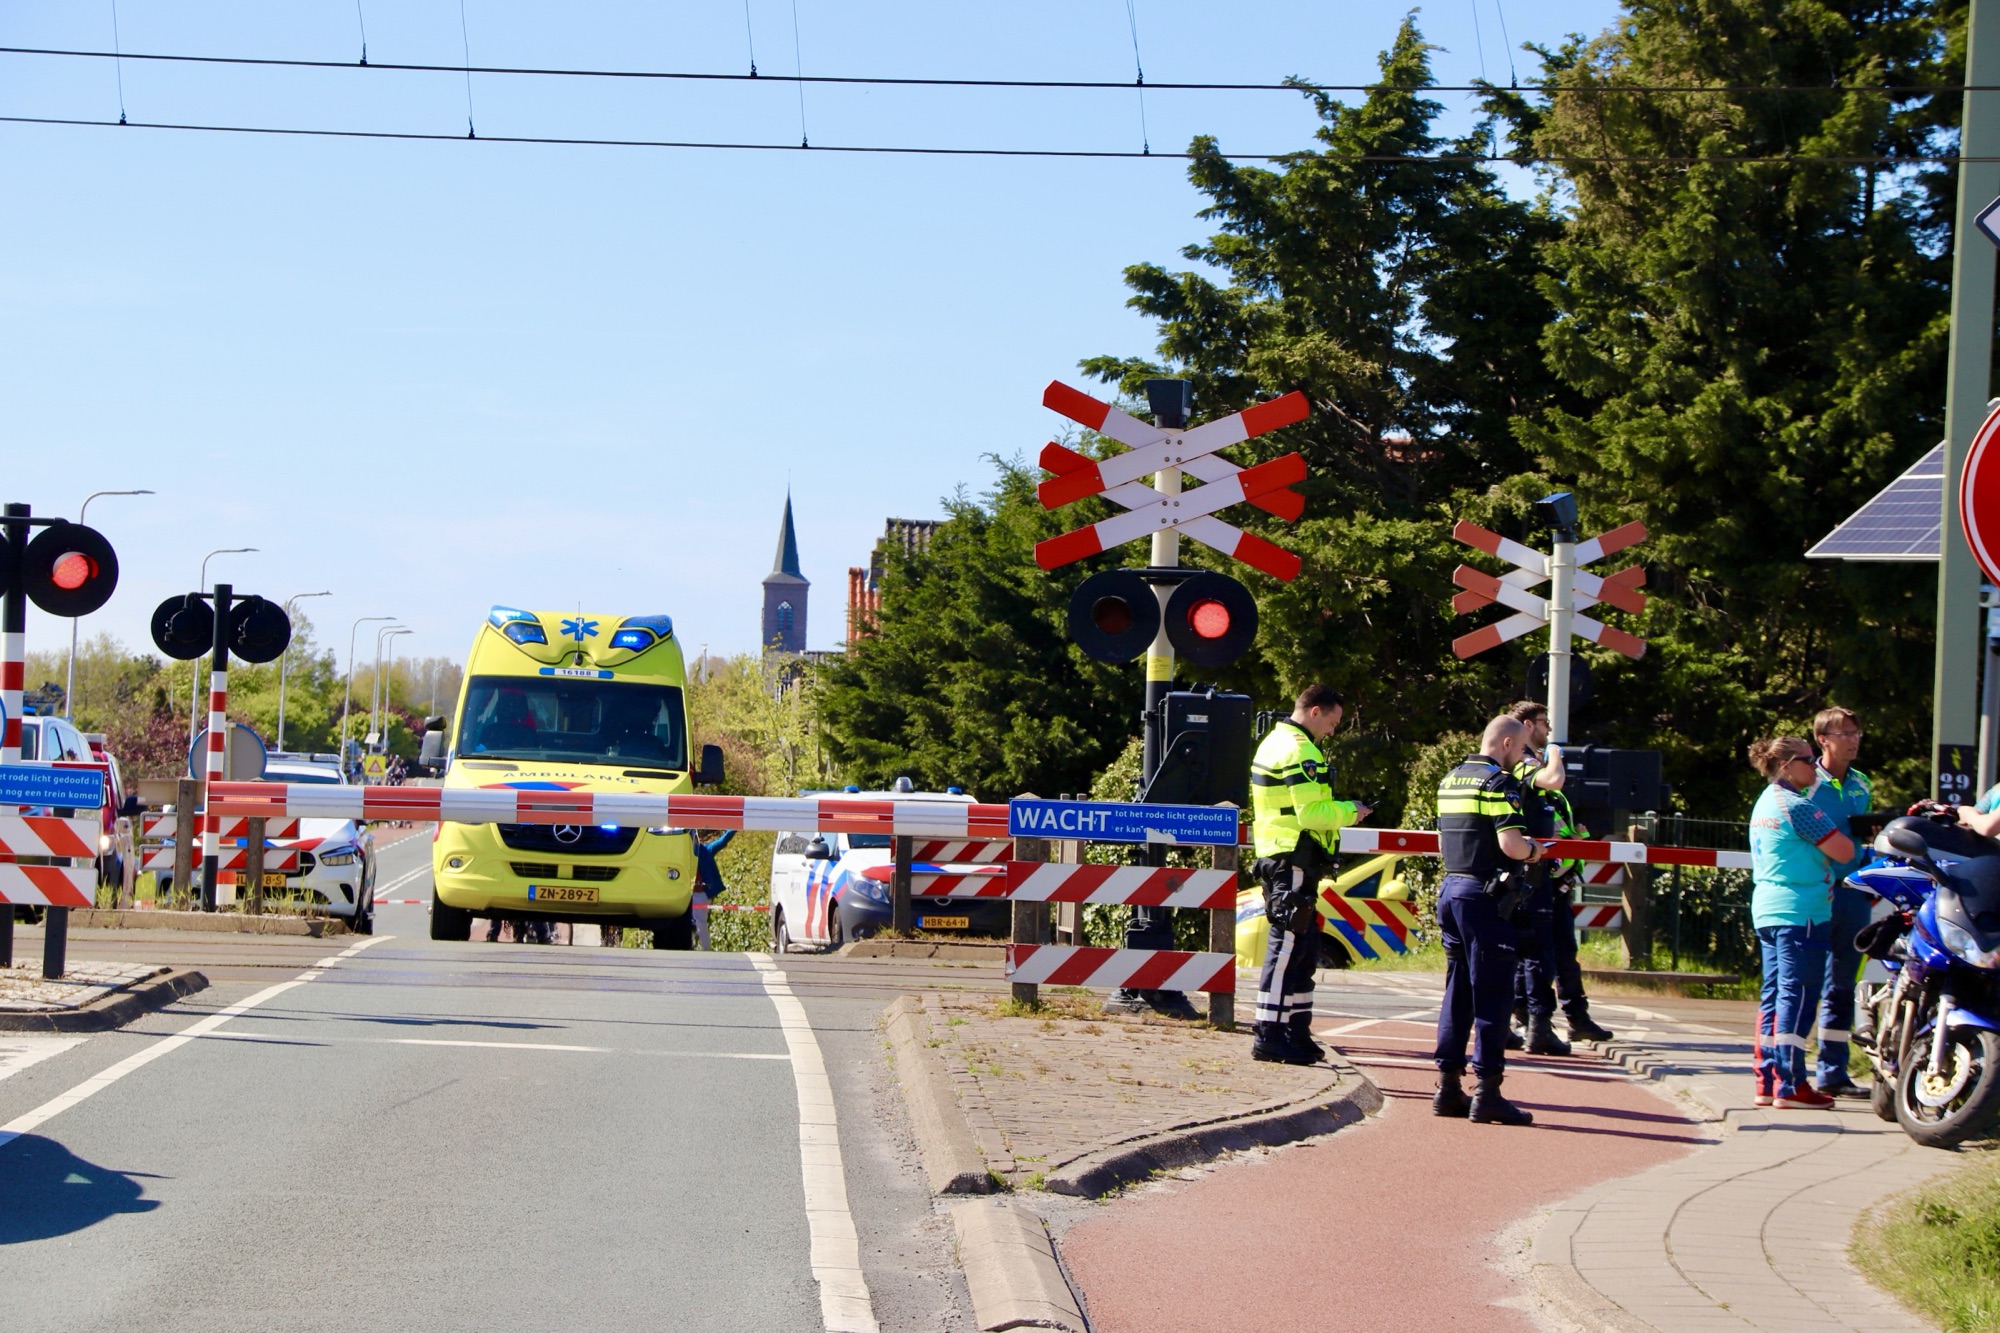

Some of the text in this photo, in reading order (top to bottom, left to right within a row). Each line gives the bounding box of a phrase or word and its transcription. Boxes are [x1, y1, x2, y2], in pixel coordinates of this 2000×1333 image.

[9, 773, 29, 782] rode
[31, 774, 51, 783] licht
[53, 776, 90, 785] gedoofd
[92, 777, 99, 785] is
[503, 771, 640, 784] AMBULANCE
[1940, 772, 1970, 790] 29
[5, 788, 23, 798] nog
[25, 789, 41, 797] een
[44, 789, 66, 798] trein
[68, 790, 99, 800] komen
[1016, 807, 1112, 832] WACHT
[1115, 810, 1232, 822] tot het rode licht gedoofd is
[1126, 825, 1141, 833] kan
[1180, 828, 1201, 836] trein
[1203, 829, 1232, 837] komen
[540, 887, 594, 901] ZN-289-Z
[924, 918, 967, 927] HBR-64-H
